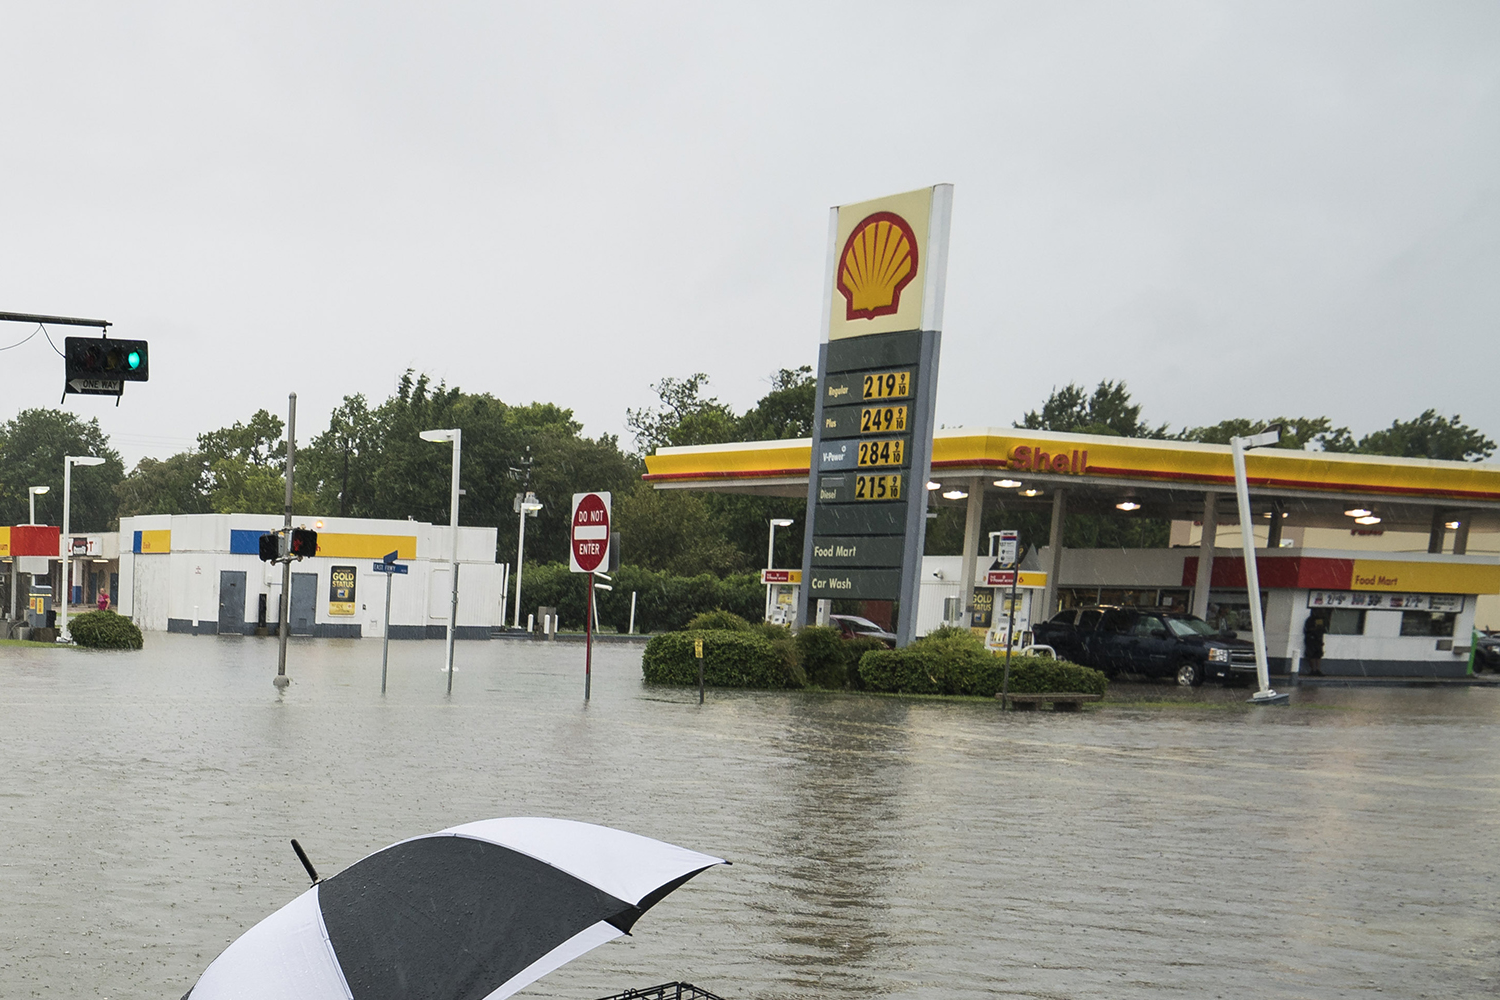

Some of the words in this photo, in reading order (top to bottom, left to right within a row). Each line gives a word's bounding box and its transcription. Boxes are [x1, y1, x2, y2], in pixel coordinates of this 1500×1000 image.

[828, 384, 849, 398] Regular
[864, 373, 896, 398] 219
[825, 418, 837, 428] Plus
[862, 408, 894, 431] 249
[822, 452, 846, 462] V-Power
[860, 441, 890, 465] 284
[1013, 445, 1088, 473] Shell
[820, 488, 837, 499] Diesel
[856, 475, 887, 498] 215
[578, 511, 588, 523] DO
[591, 510, 604, 522] NOT
[579, 543, 600, 555] ENTER
[814, 545, 834, 557] Food
[835, 545, 857, 557] Mart
[332, 572, 354, 581] GOLD
[1355, 575, 1377, 586] Food
[1377, 575, 1398, 586] Mart
[811, 578, 827, 589] Car
[828, 577, 852, 589] Wash
[973, 603, 992, 612] TATUS
